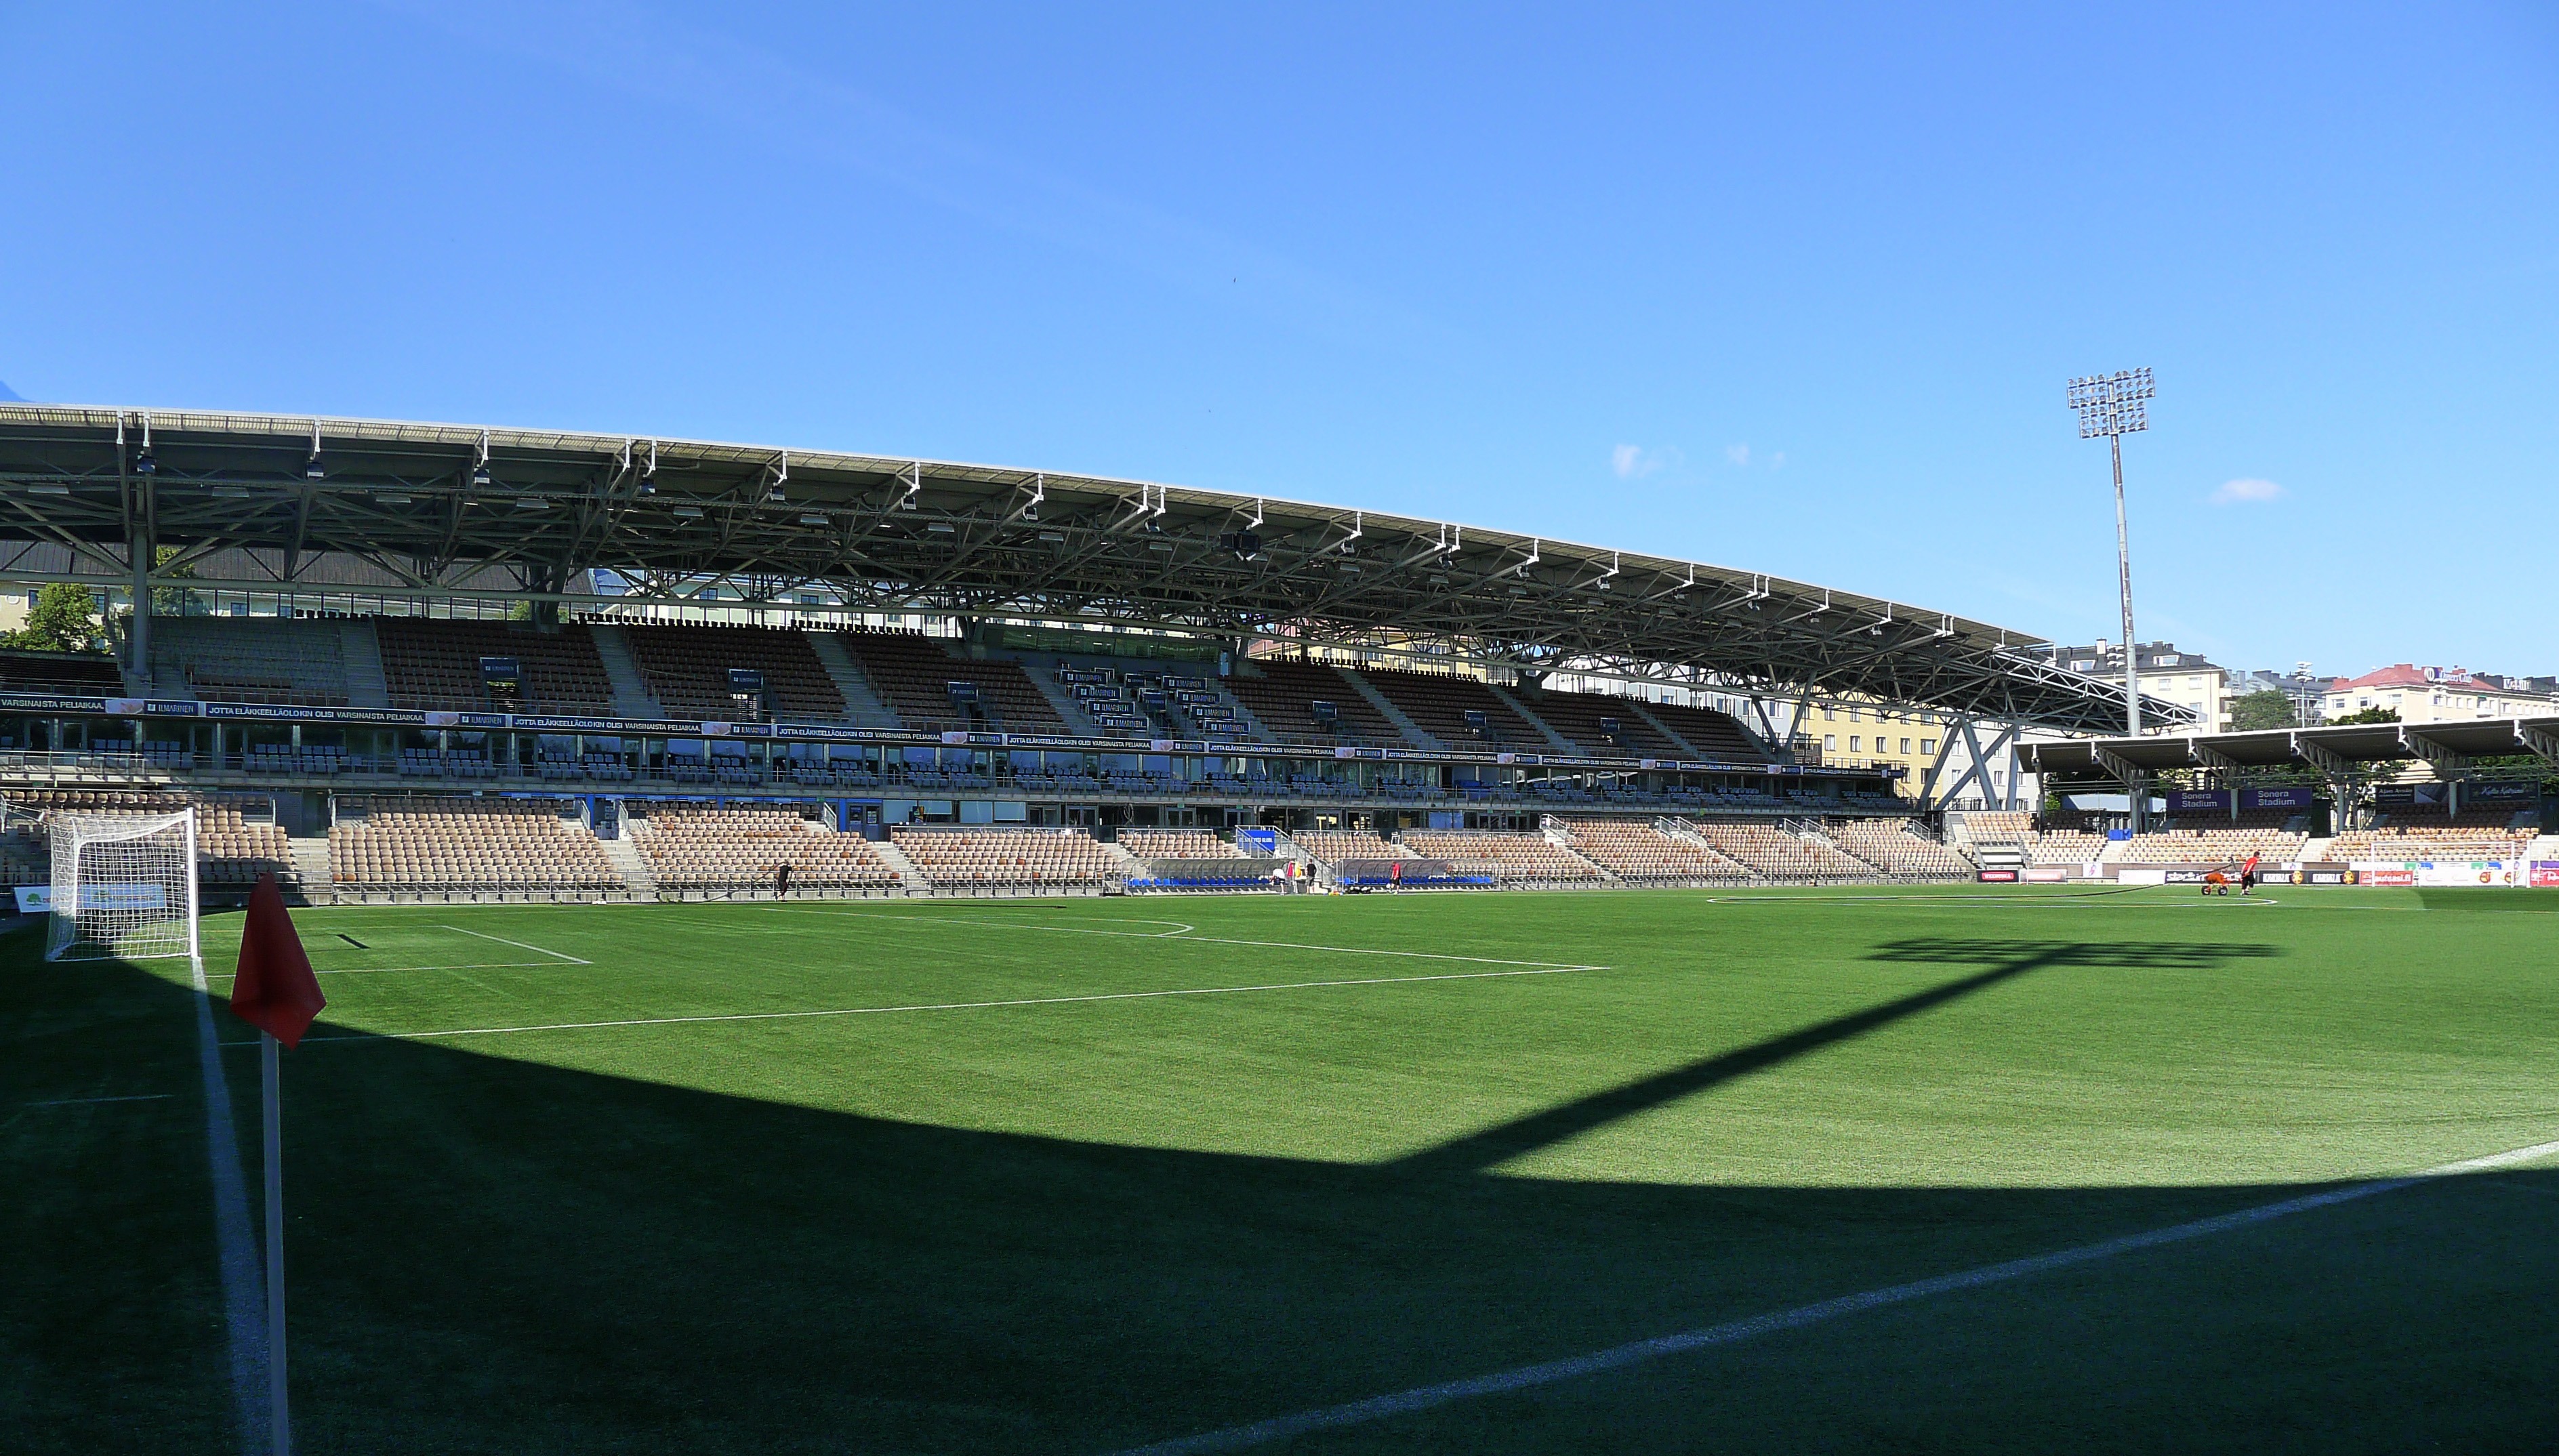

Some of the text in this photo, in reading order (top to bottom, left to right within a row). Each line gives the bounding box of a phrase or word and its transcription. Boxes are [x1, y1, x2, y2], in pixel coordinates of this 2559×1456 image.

[1, 699, 104, 709] VARSINAISTA PELIAIKAA.
[159, 705, 194, 713] ILMARINEN
[209, 707, 234, 715] JOTTA
[337, 712, 384, 720] VARSINAISTA
[386, 713, 425, 722] PELIAIKAA.
[875, 732, 912, 740] VARSINAISTA
[2258, 798, 2295, 806] Stadium
